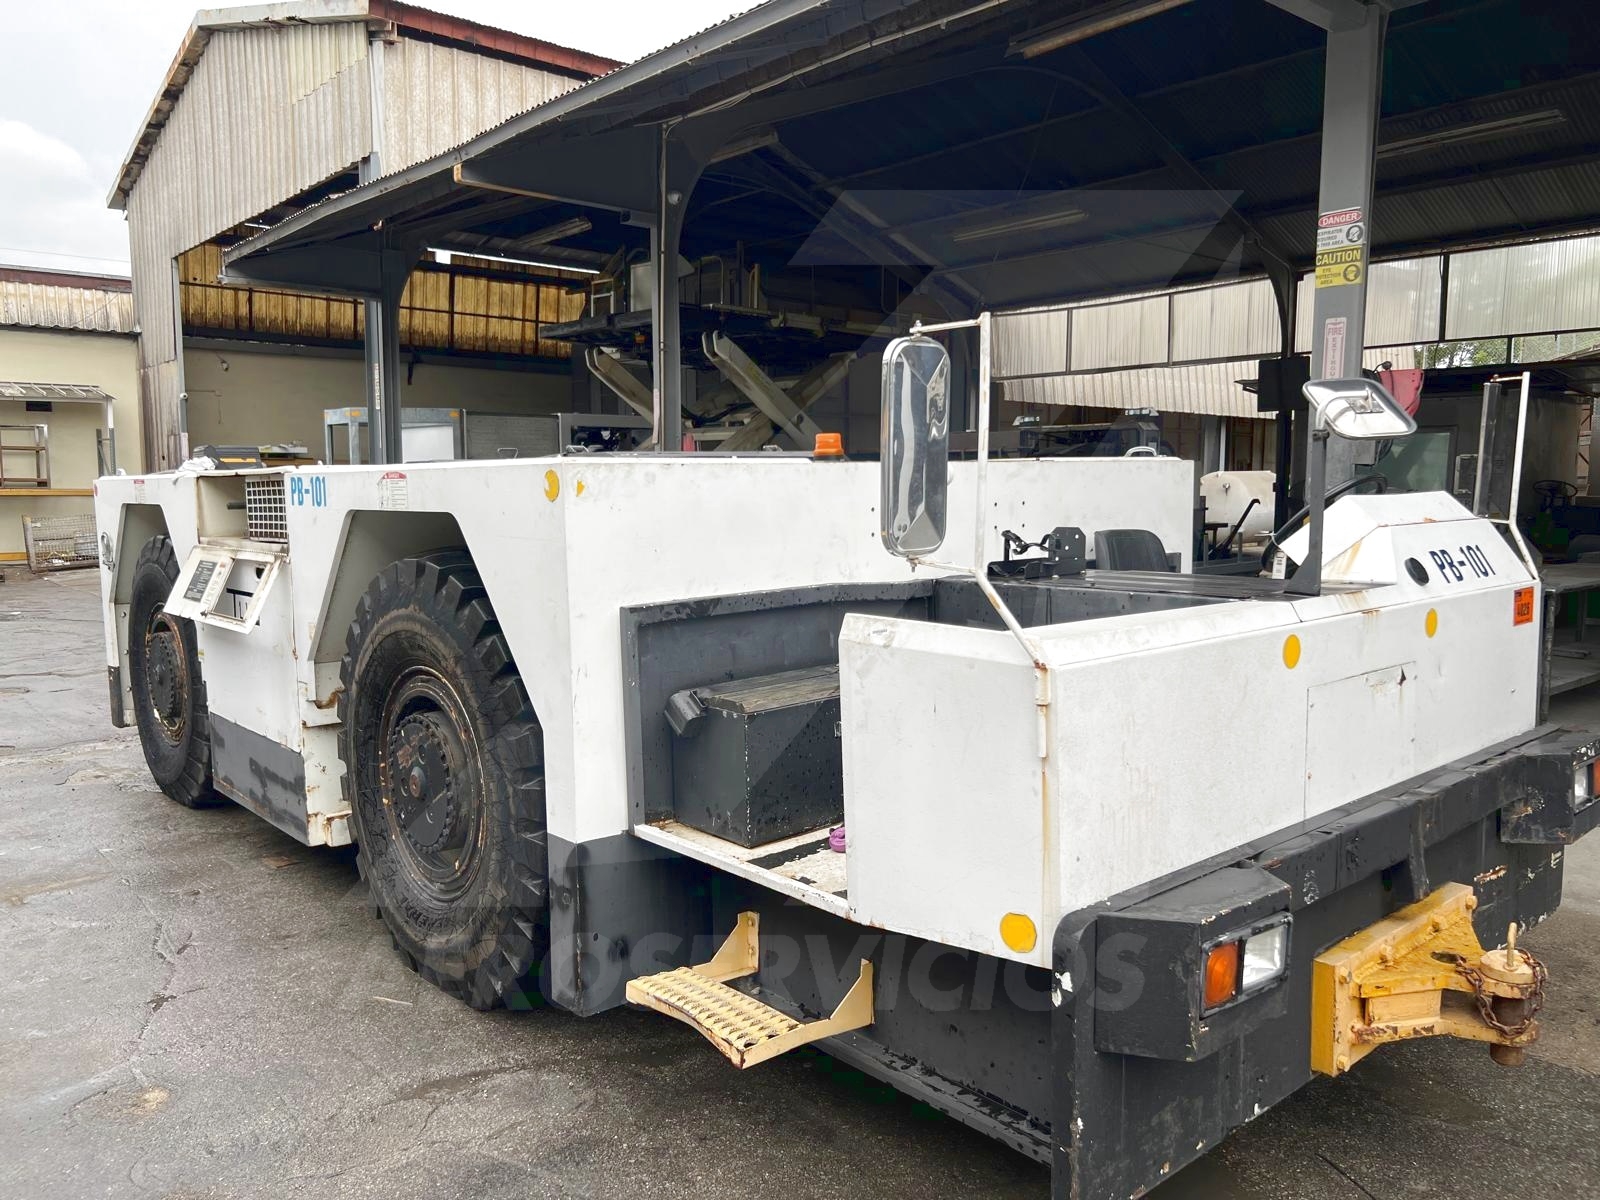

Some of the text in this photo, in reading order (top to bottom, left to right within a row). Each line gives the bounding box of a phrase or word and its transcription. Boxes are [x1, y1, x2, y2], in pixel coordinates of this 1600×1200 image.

[1322, 212, 1357, 226] DANGER
[1316, 250, 1360, 266] CAUTION
[1328, 327, 1343, 336] FIRE
[290, 476, 327, 507] PB-101
[1429, 545, 1496, 583] PB-101
